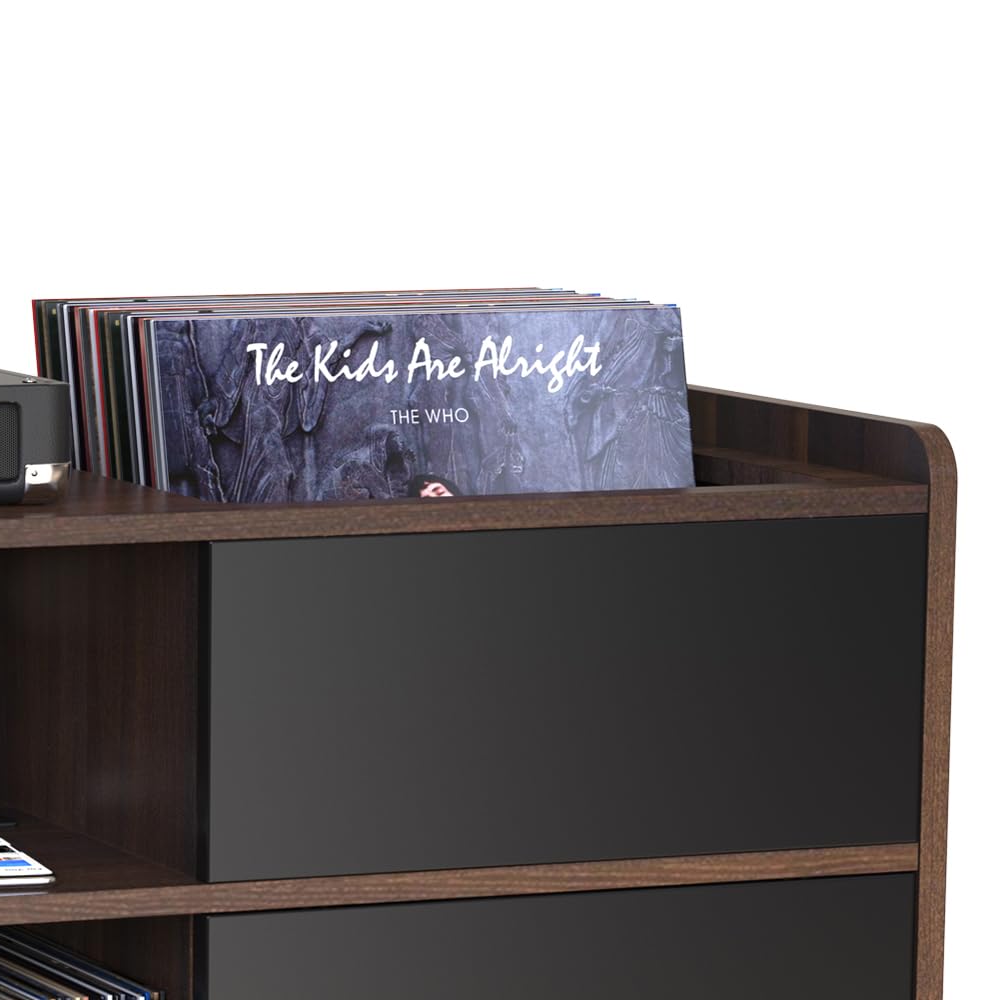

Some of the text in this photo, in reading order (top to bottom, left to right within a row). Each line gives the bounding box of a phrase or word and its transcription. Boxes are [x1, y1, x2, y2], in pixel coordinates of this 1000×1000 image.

[246, 335, 602, 393] The Kids Are Alright
[390, 407, 469, 425] THE WHO
